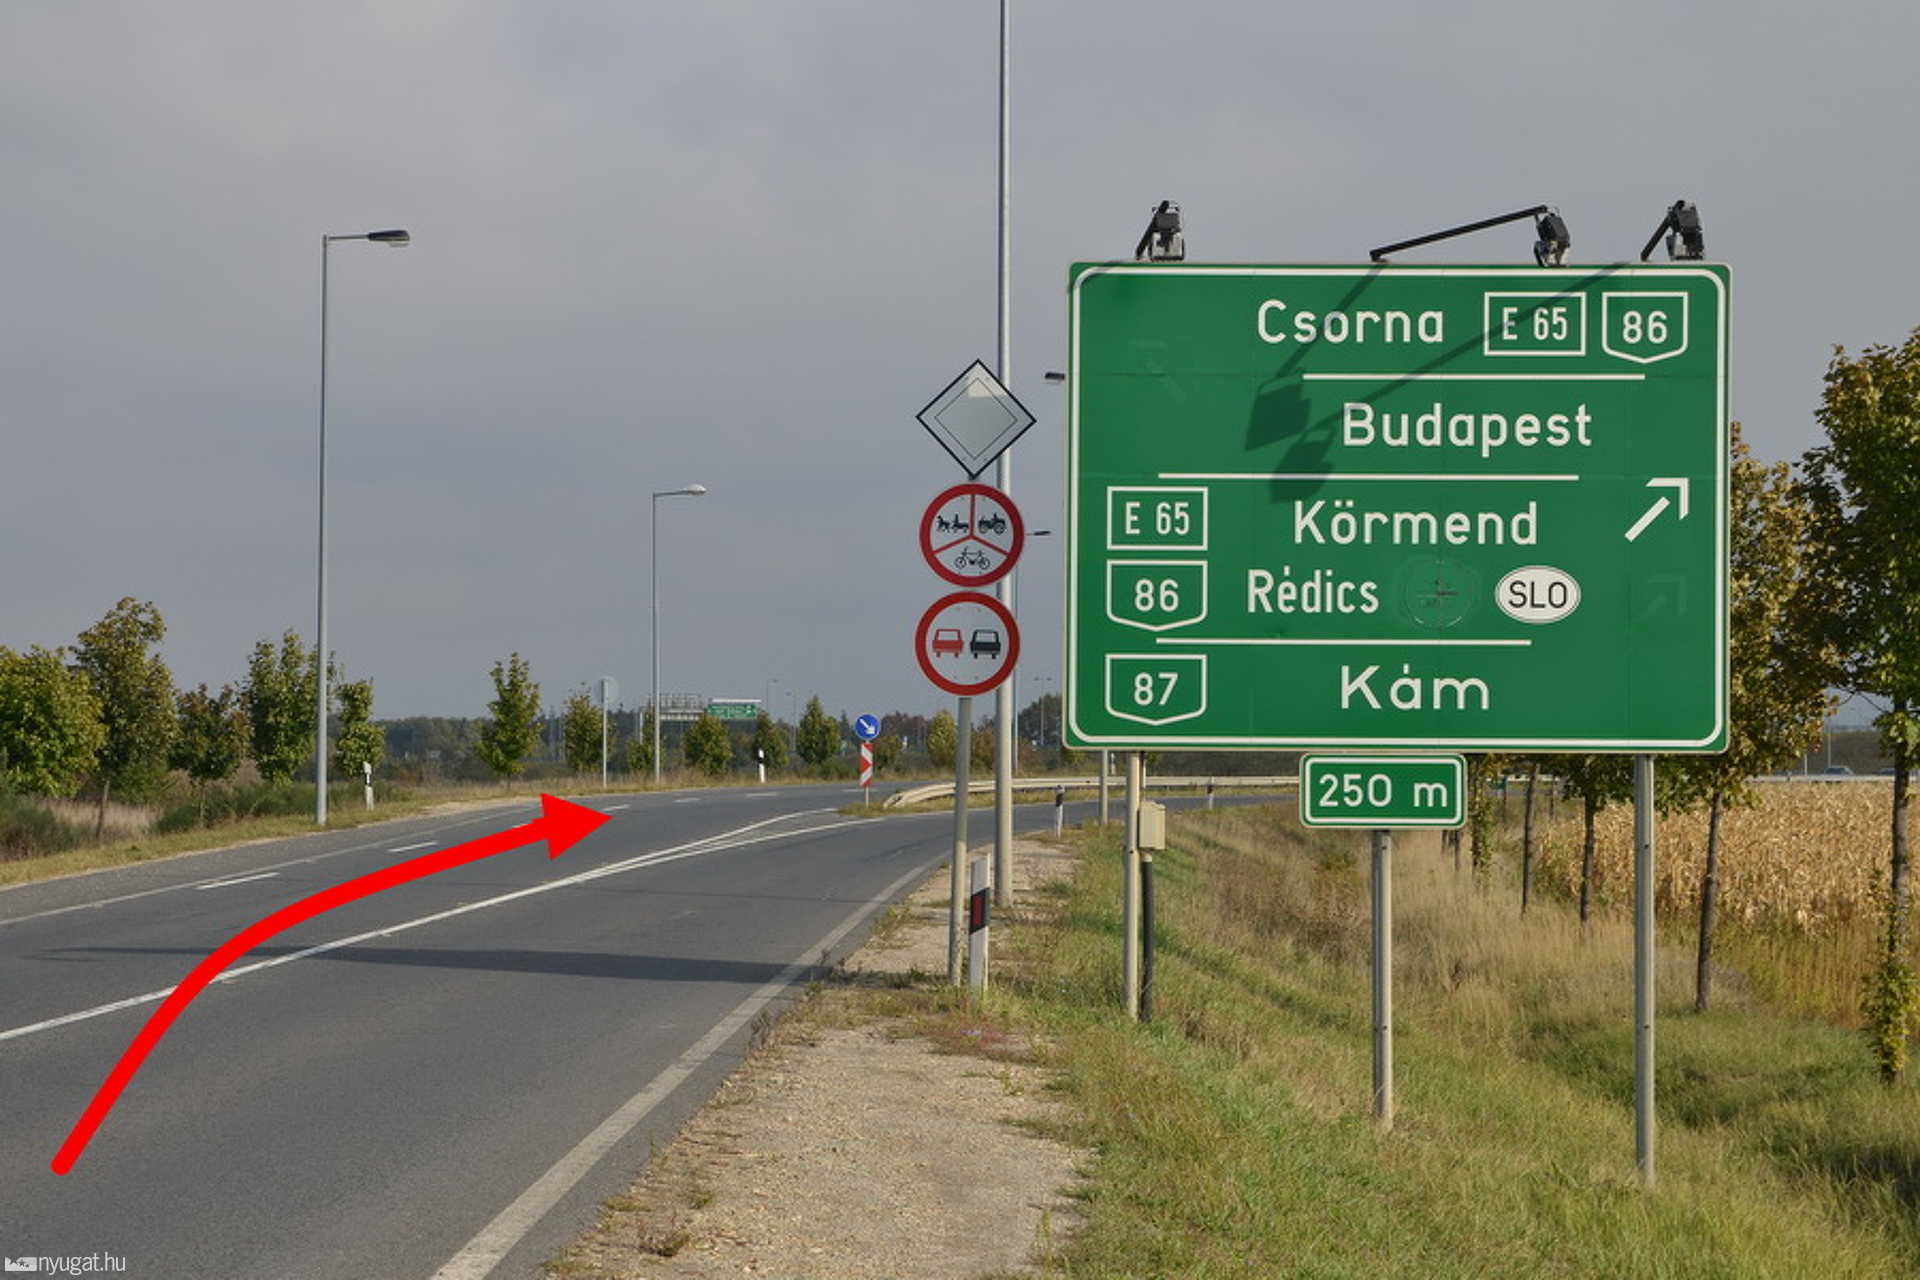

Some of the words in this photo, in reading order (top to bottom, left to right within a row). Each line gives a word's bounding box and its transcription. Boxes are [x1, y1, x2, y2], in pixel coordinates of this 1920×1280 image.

[1257, 299, 1444, 344] Csorna
[1502, 306, 1518, 341] E
[1533, 306, 1568, 341] 65
[1622, 310, 1668, 344] 86
[1343, 402, 1592, 458] Budapest
[1125, 501, 1141, 535] E
[1156, 501, 1190, 535] 65
[1294, 499, 1538, 545] Körmend
[1134, 578, 1179, 612] 86
[1247, 565, 1379, 614] Rédics
[1508, 580, 1568, 609] SLO
[1134, 672, 1179, 706] 87
[1341, 663, 1489, 710] Kám
[1319, 773, 1392, 807] 250
[1413, 781, 1448, 808] m
